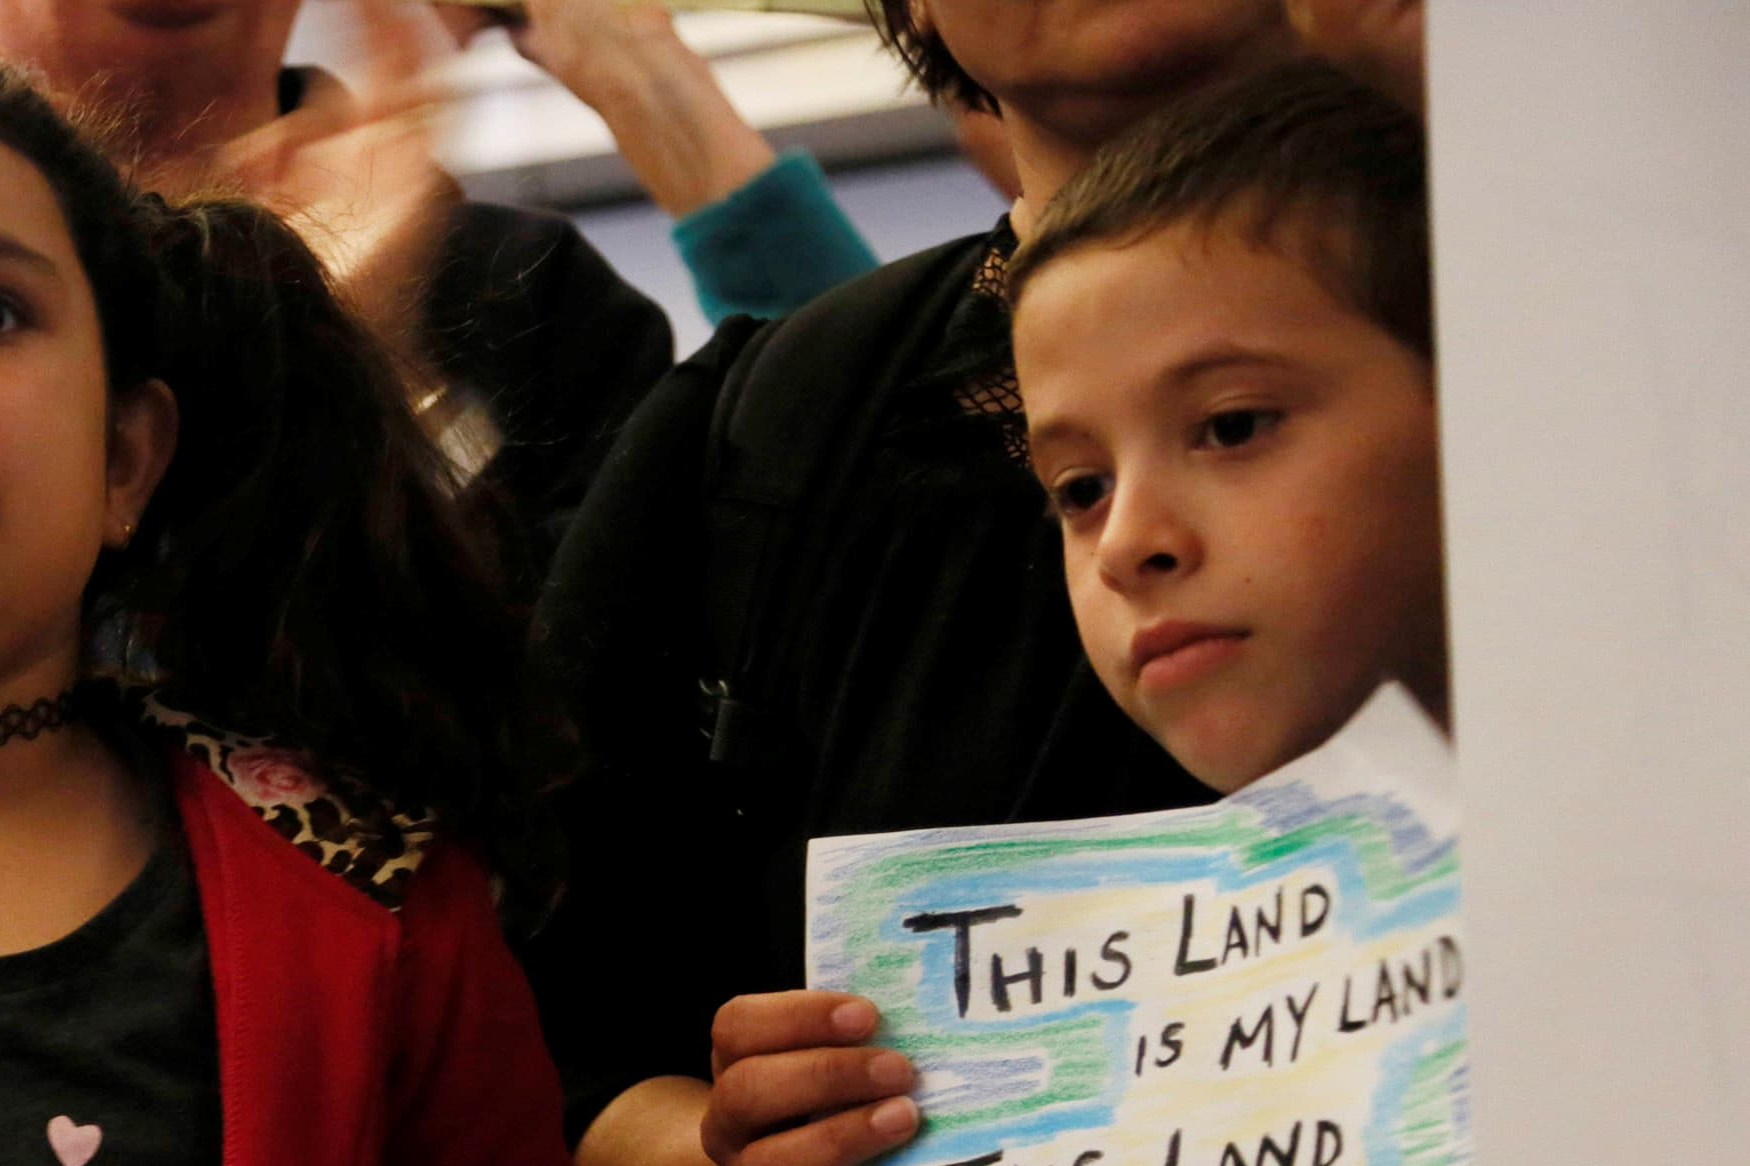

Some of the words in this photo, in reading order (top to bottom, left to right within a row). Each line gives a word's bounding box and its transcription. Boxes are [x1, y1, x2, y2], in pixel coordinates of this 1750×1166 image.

[902, 903, 1132, 1018] THIS
[1174, 883, 1331, 976] LAND
[1134, 1021, 1186, 1077] IS
[1221, 981, 1319, 1071] MY
[1336, 934, 1465, 1033] LAND
